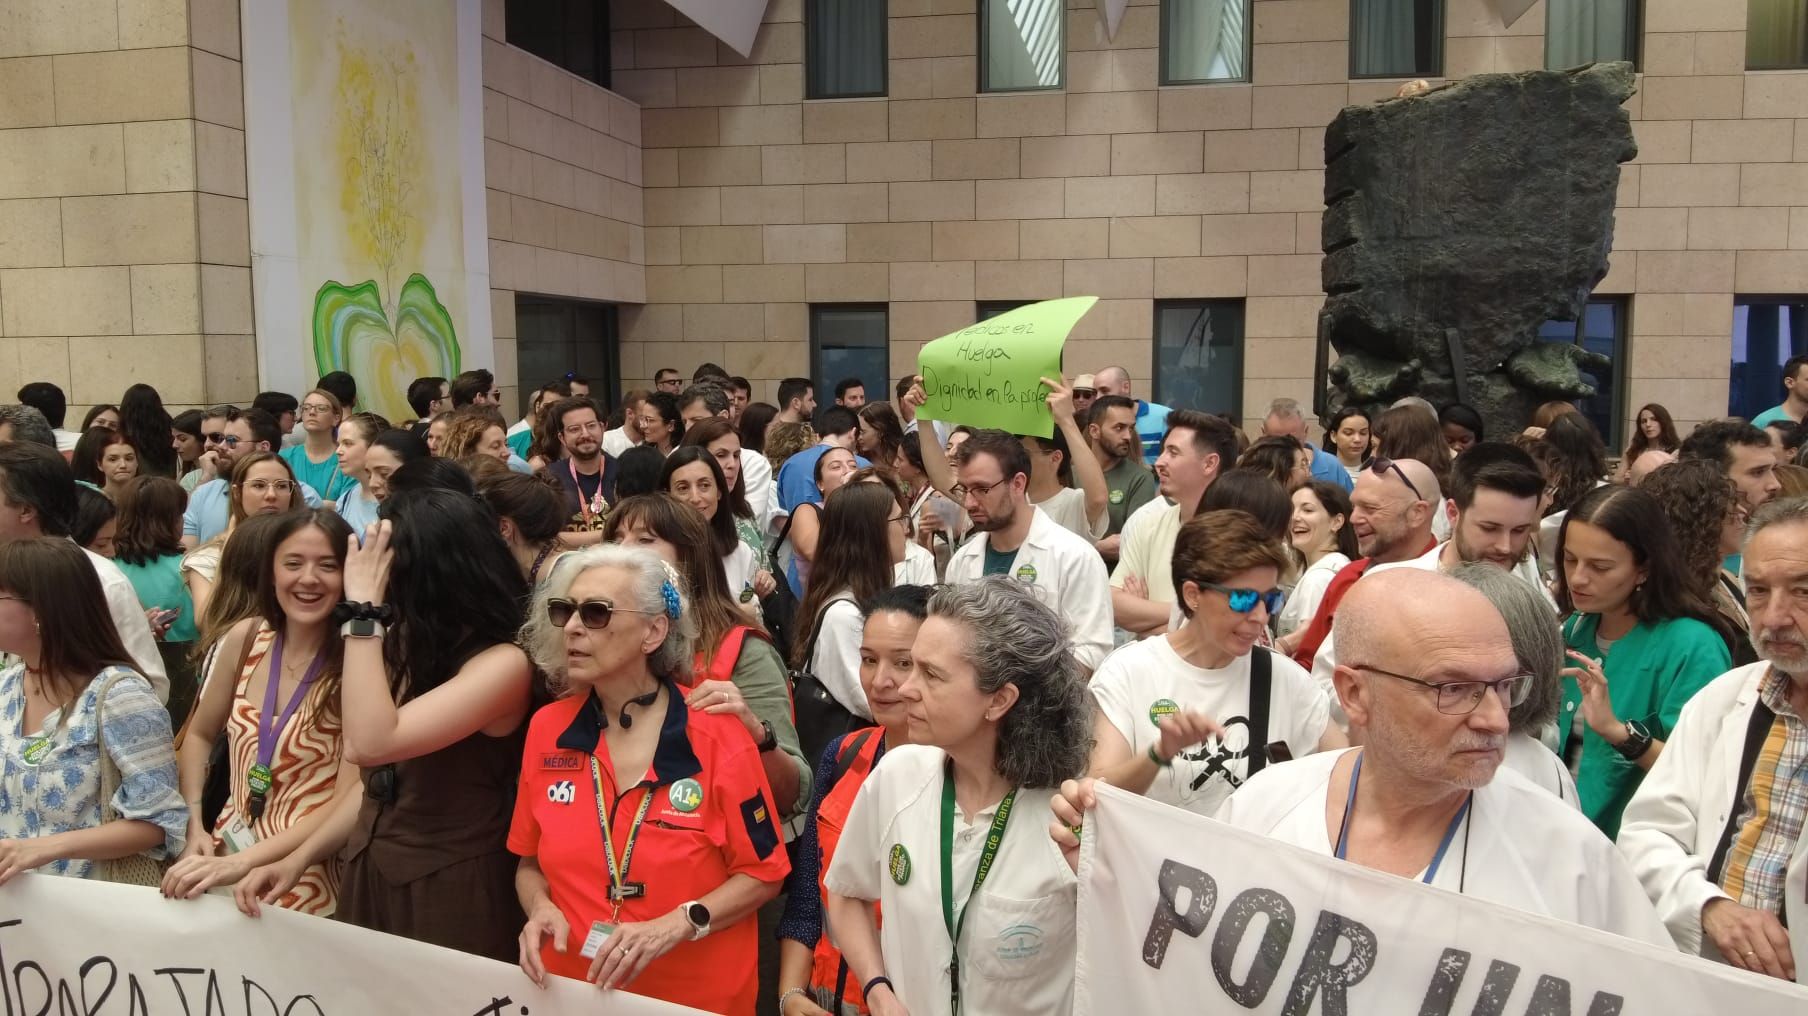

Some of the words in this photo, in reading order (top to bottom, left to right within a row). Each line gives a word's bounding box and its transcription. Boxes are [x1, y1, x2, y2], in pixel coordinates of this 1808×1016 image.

[956, 341, 1011, 376] Huelga
[922, 365, 981, 412] Dignidad
[986, 387, 1001, 404] en
[1020, 381, 1050, 414] profe
[547, 780, 576, 804] 061
[991, 798, 1012, 831] Triana
[988, 835, 1000, 850] de
[1142, 858, 1378, 1016] POR
